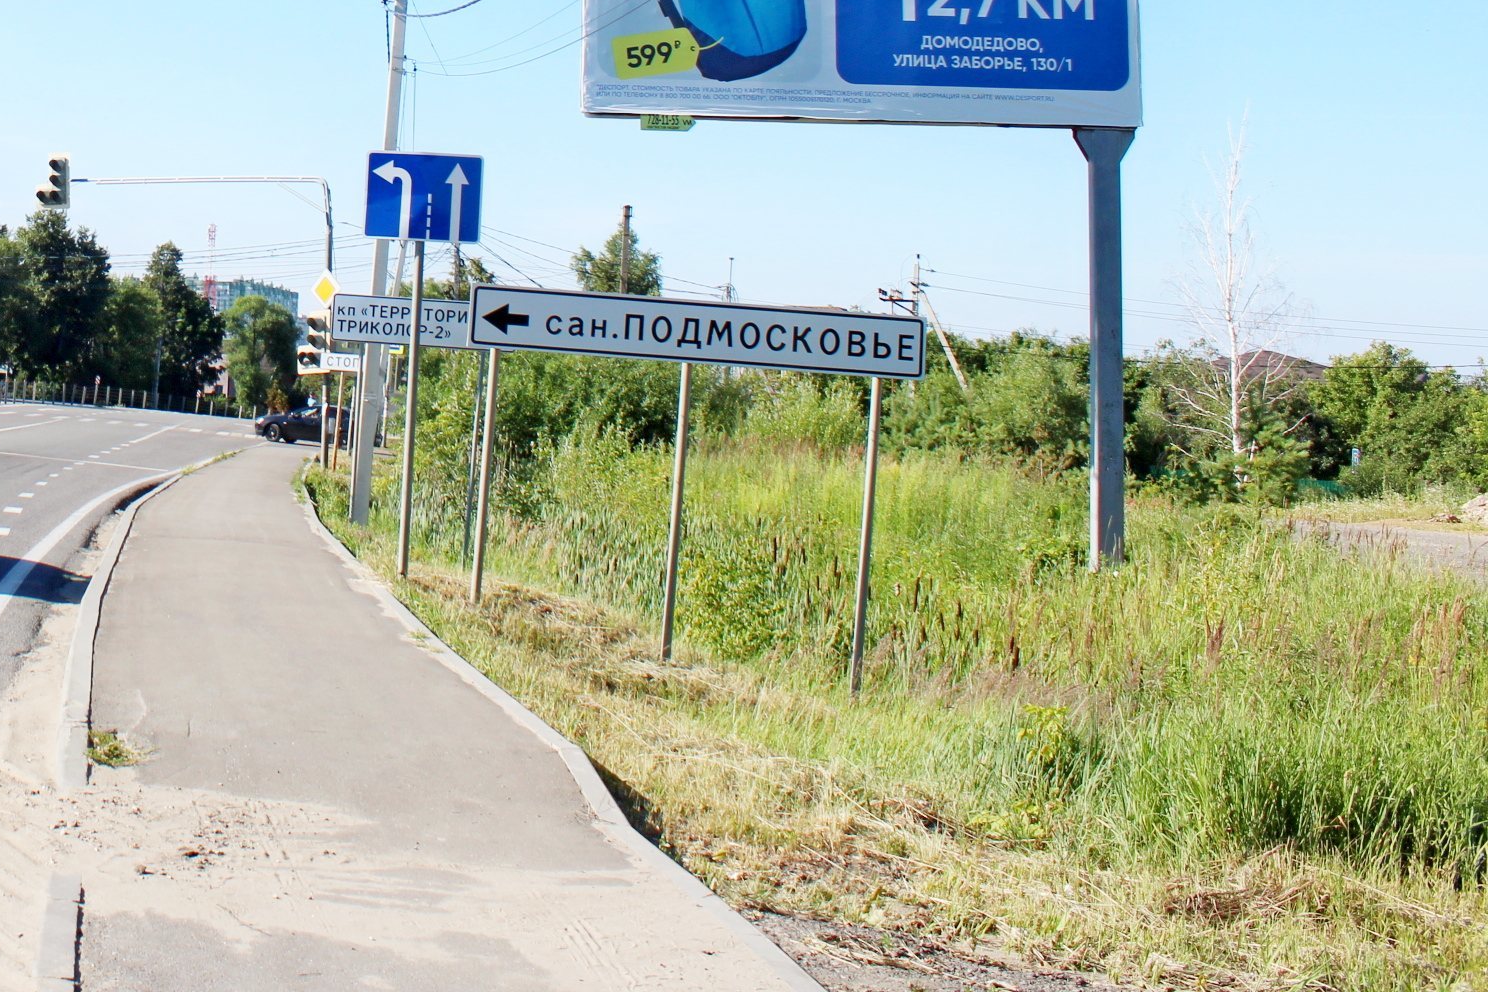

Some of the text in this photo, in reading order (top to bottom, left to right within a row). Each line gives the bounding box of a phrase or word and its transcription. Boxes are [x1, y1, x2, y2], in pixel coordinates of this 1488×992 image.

[920, 35, 1044, 53] ДОМОДЕДОВО,
[893, 54, 1073, 73] УЛИЦА ЗАБОРЬЕ, 130/1
[337, 306, 355, 316] кп
